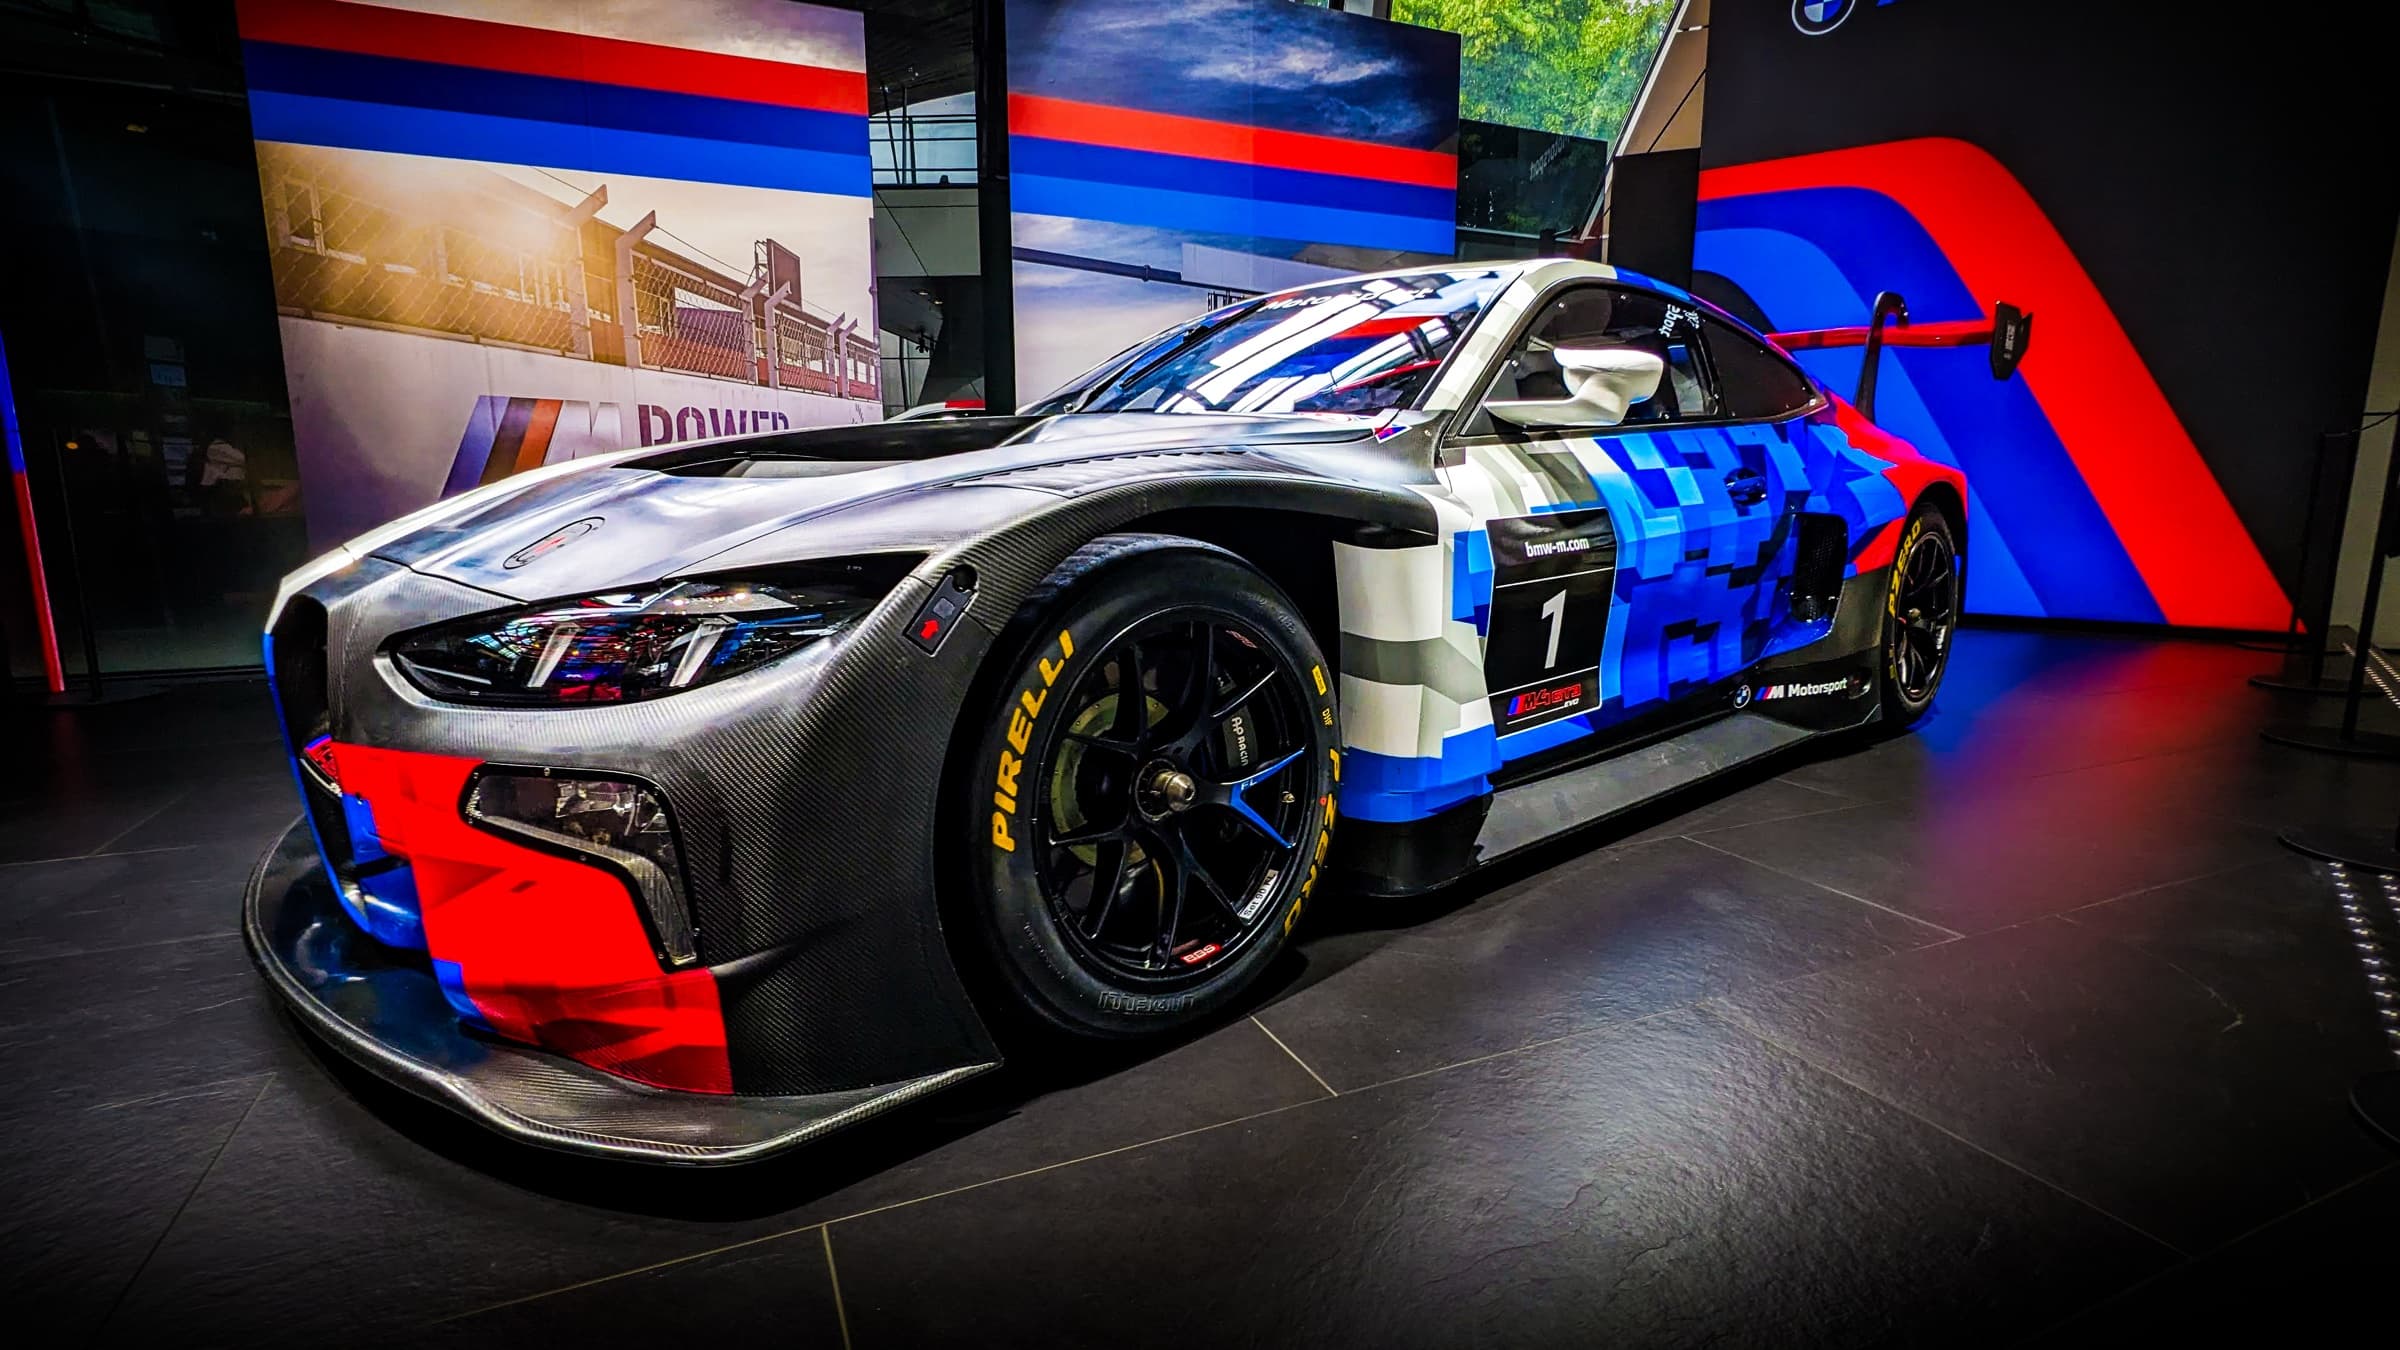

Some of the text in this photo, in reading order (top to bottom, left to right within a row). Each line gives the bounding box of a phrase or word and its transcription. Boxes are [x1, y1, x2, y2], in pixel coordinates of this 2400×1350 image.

[1524, 538, 1590, 558] bmw-m.com
[1541, 588, 1567, 670] 1
[1788, 677, 1848, 698] Motorsport
[992, 629, 1074, 852] PIRELLI
[1237, 735, 1249, 767] RACIN
